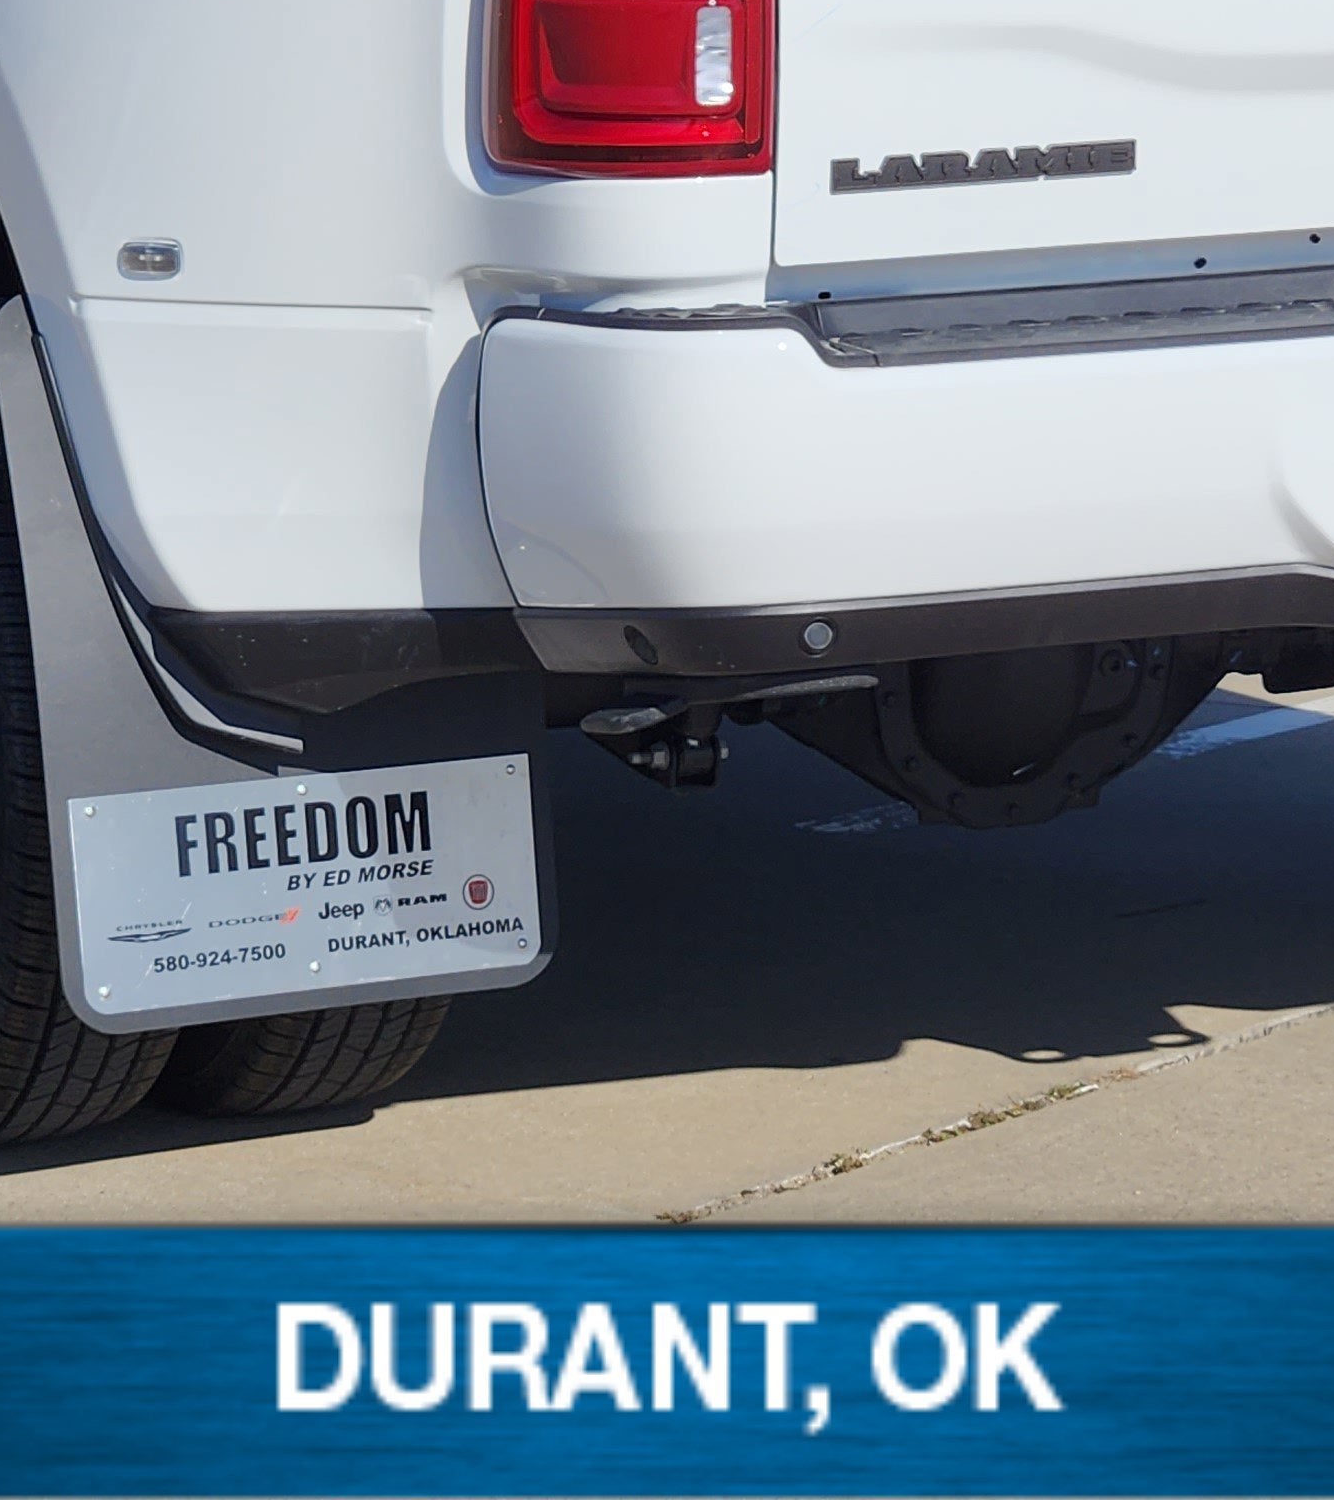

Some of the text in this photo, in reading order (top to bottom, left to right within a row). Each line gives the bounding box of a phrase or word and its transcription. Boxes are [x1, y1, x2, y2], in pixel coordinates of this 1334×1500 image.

[830, 138, 1136, 194] LARAMIE
[174, 790, 432, 878] FREEDOM
[287, 859, 434, 891] BY ED MORSE
[116, 893, 448, 932] CHRYSLER DODGE Jeep RAM
[328, 916, 525, 953] DURANT, OKLAHOMA
[153, 943, 287, 973] 580-924-7500
